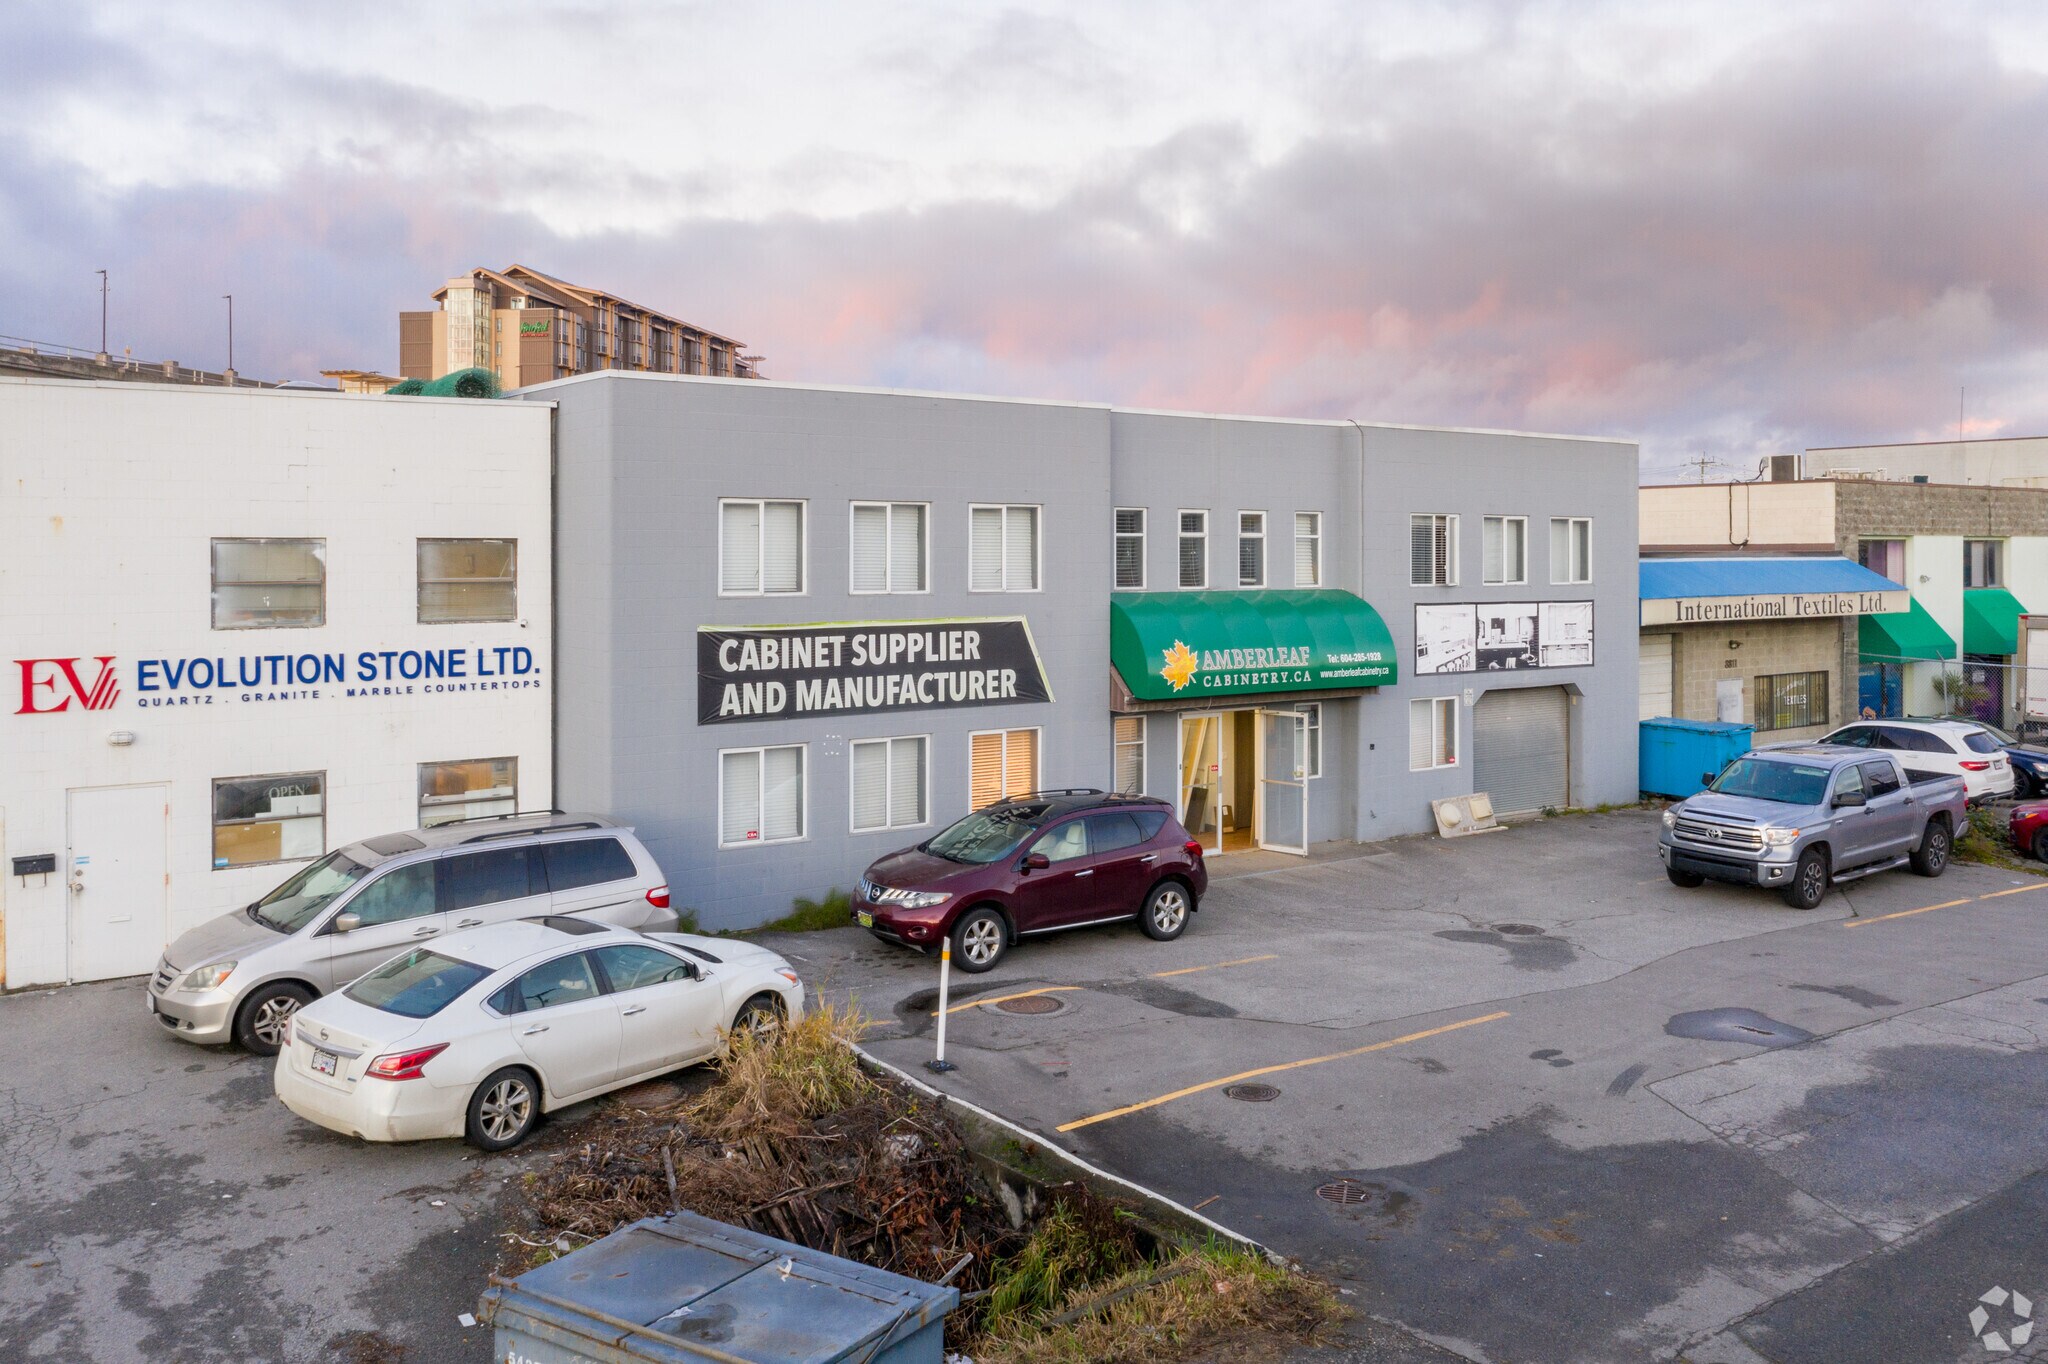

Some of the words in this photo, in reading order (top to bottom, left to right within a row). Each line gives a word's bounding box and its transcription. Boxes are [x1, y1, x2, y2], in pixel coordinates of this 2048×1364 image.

[1675, 596, 1787, 622] International
[1792, 594, 1854, 616] Textiles
[1858, 593, 1888, 613] Ltd.
[718, 635, 846, 673] CABINET
[850, 630, 981, 667] SUPPLIER
[1202, 646, 1310, 671] AMBERLEAF
[1327, 654, 1339, 663] Tel:
[137, 653, 345, 691] EVOLUTION
[356, 648, 467, 682] STONE
[477, 646, 541, 677] LTD.
[1203, 670, 1312, 688] CABINETRY.CA
[138, 695, 213, 707] QUARTZ
[241, 690, 320, 702] GRANITE
[346, 686, 414, 697] MARBLE
[424, 679, 541, 693] COUNTERTOPS
[719, 681, 787, 717] AND
[795, 668, 1018, 712] MANUFACTURER
[268, 784, 305, 798] OPEN
